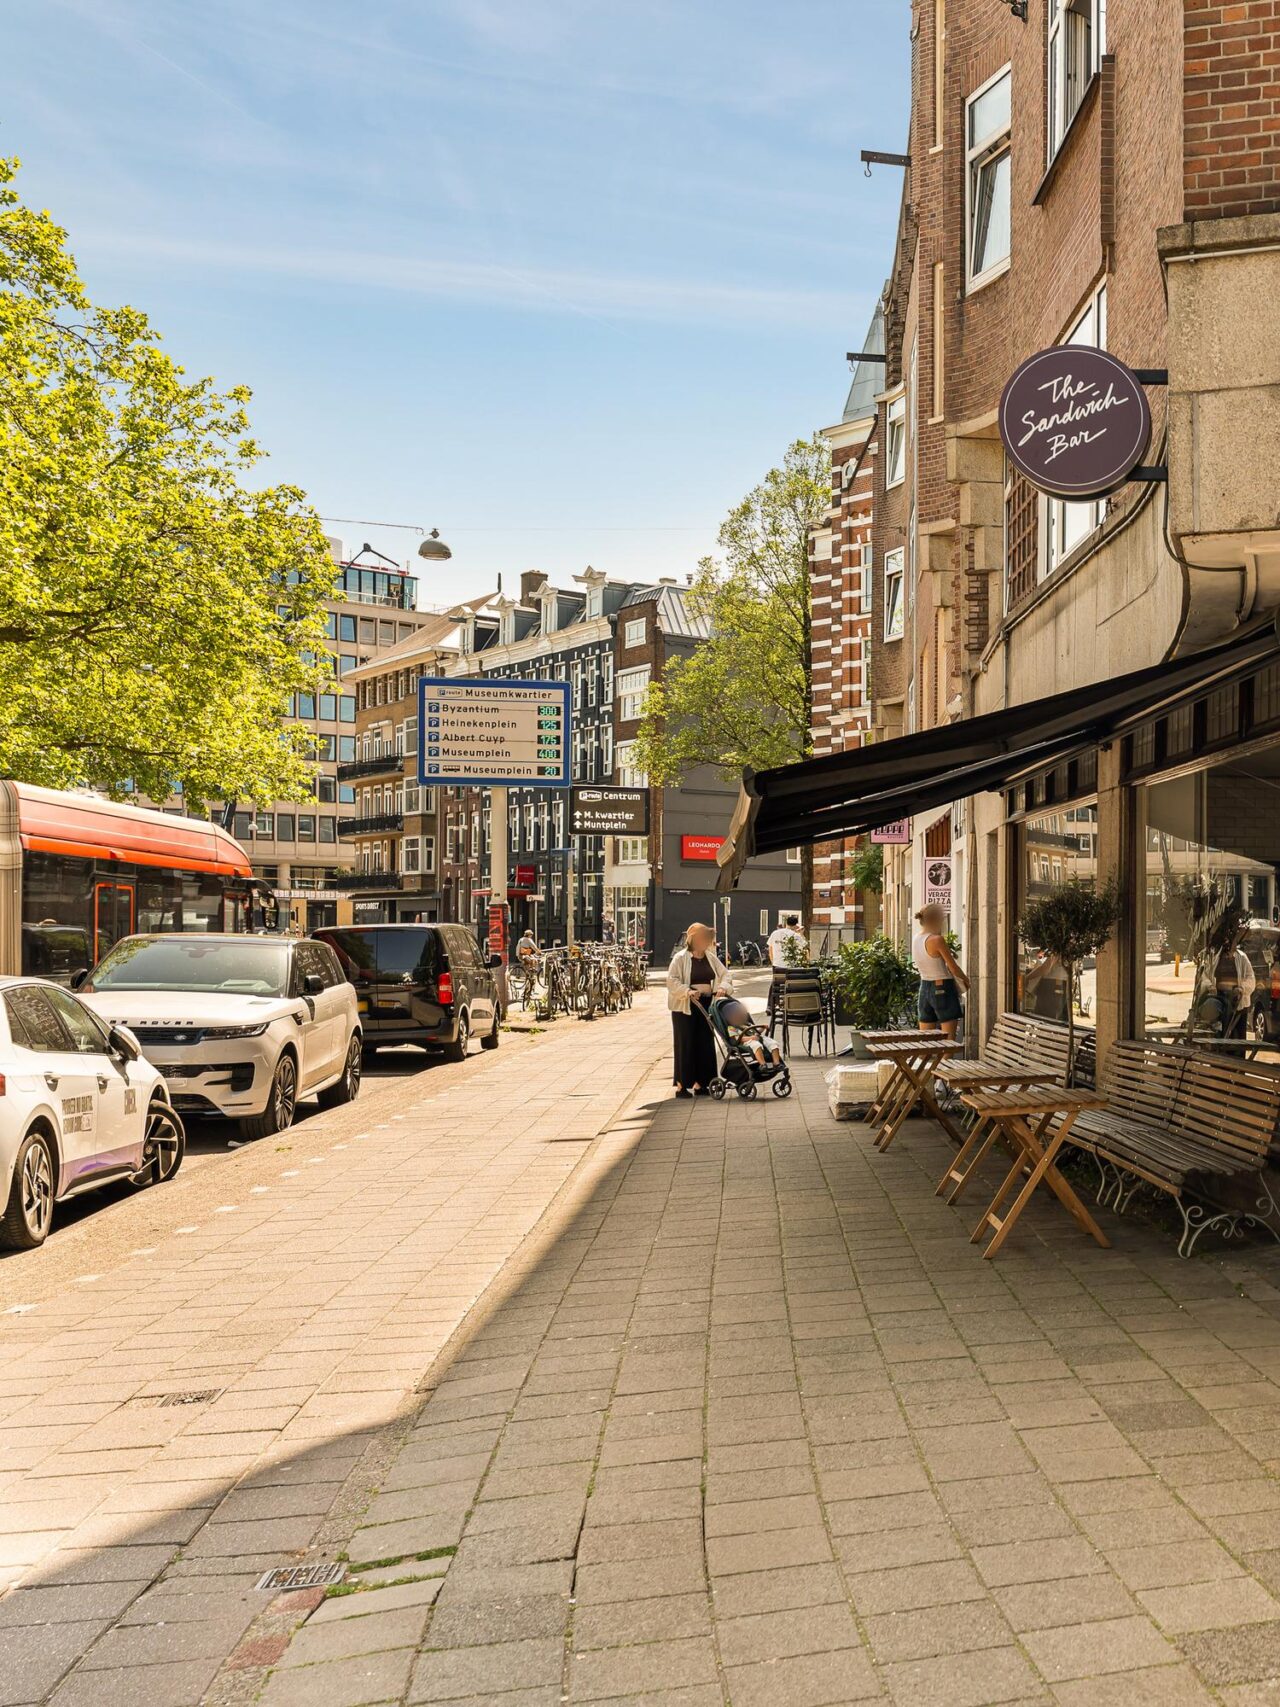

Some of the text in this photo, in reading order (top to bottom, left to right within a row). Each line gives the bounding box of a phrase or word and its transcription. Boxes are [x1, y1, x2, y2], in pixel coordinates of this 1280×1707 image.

[1037, 374, 1097, 404] The
[1018, 382, 1129, 447] Sandwich
[1044, 428, 1107, 464] Bar
[465, 689, 552, 699] Museumkwartier
[442, 704, 500, 714] Byzantium
[539, 706, 557, 715] 300
[442, 719, 517, 729] Heinekenplein
[541, 721, 557, 730] 125
[442, 733, 475, 742] Albert
[479, 735, 506, 744] Cuyp
[541, 736, 557, 745] 175
[442, 748, 511, 758] Museumplein
[539, 750, 557, 759] 400
[463, 765, 532, 775] Museumplein
[545, 767, 557, 775] 20
[603, 792, 640, 800] Centrum
[584, 811, 635, 820] M. kwartier
[584, 821, 627, 830] Muntplein
